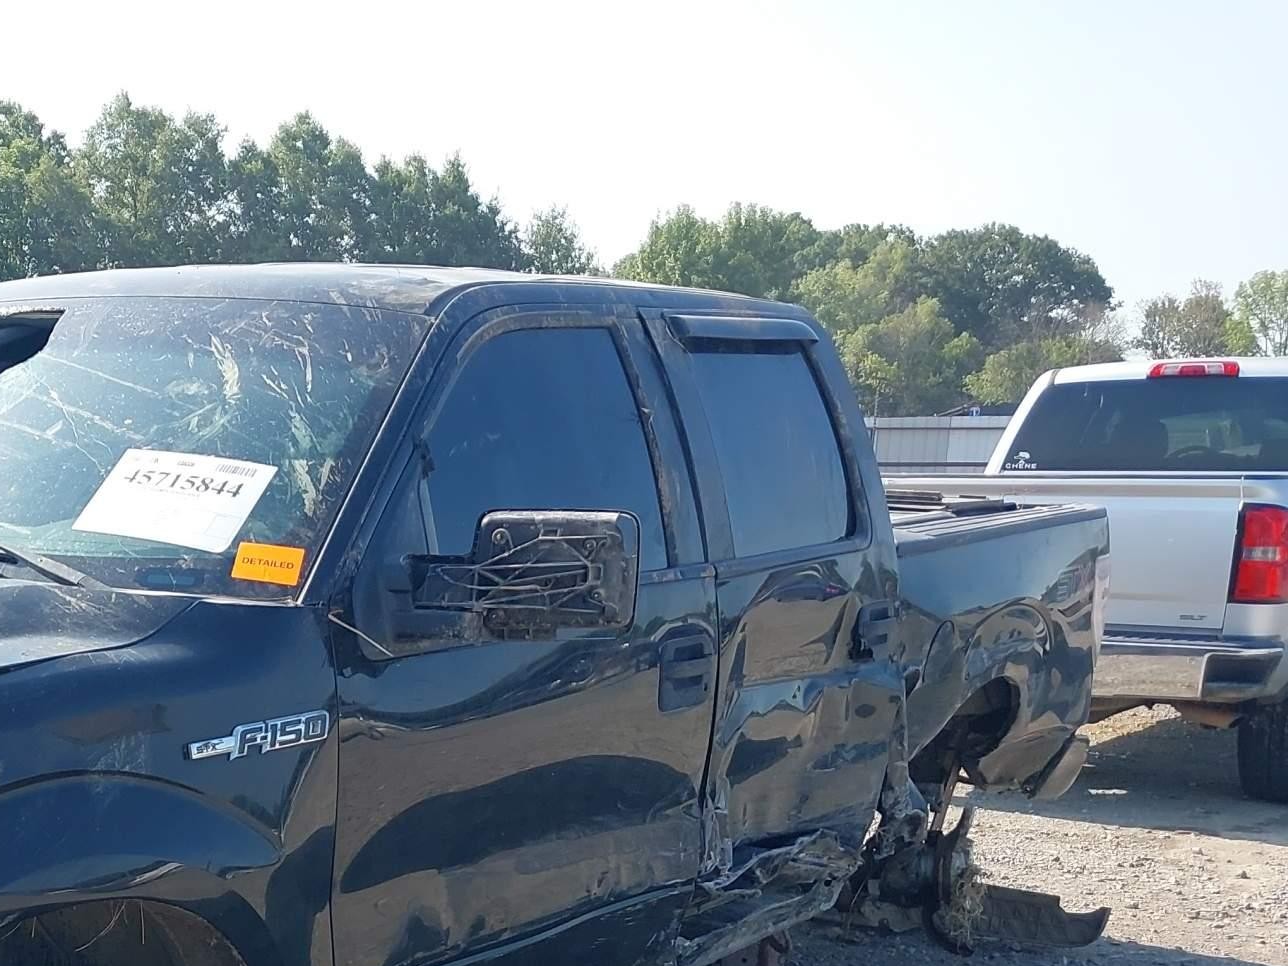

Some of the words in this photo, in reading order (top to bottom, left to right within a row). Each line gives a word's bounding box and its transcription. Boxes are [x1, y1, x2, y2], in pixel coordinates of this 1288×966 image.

[124, 469, 244, 498] 45715844
[242, 556, 294, 569] DETAILED
[195, 741, 219, 755] STX
[233, 711, 328, 759] F-150
